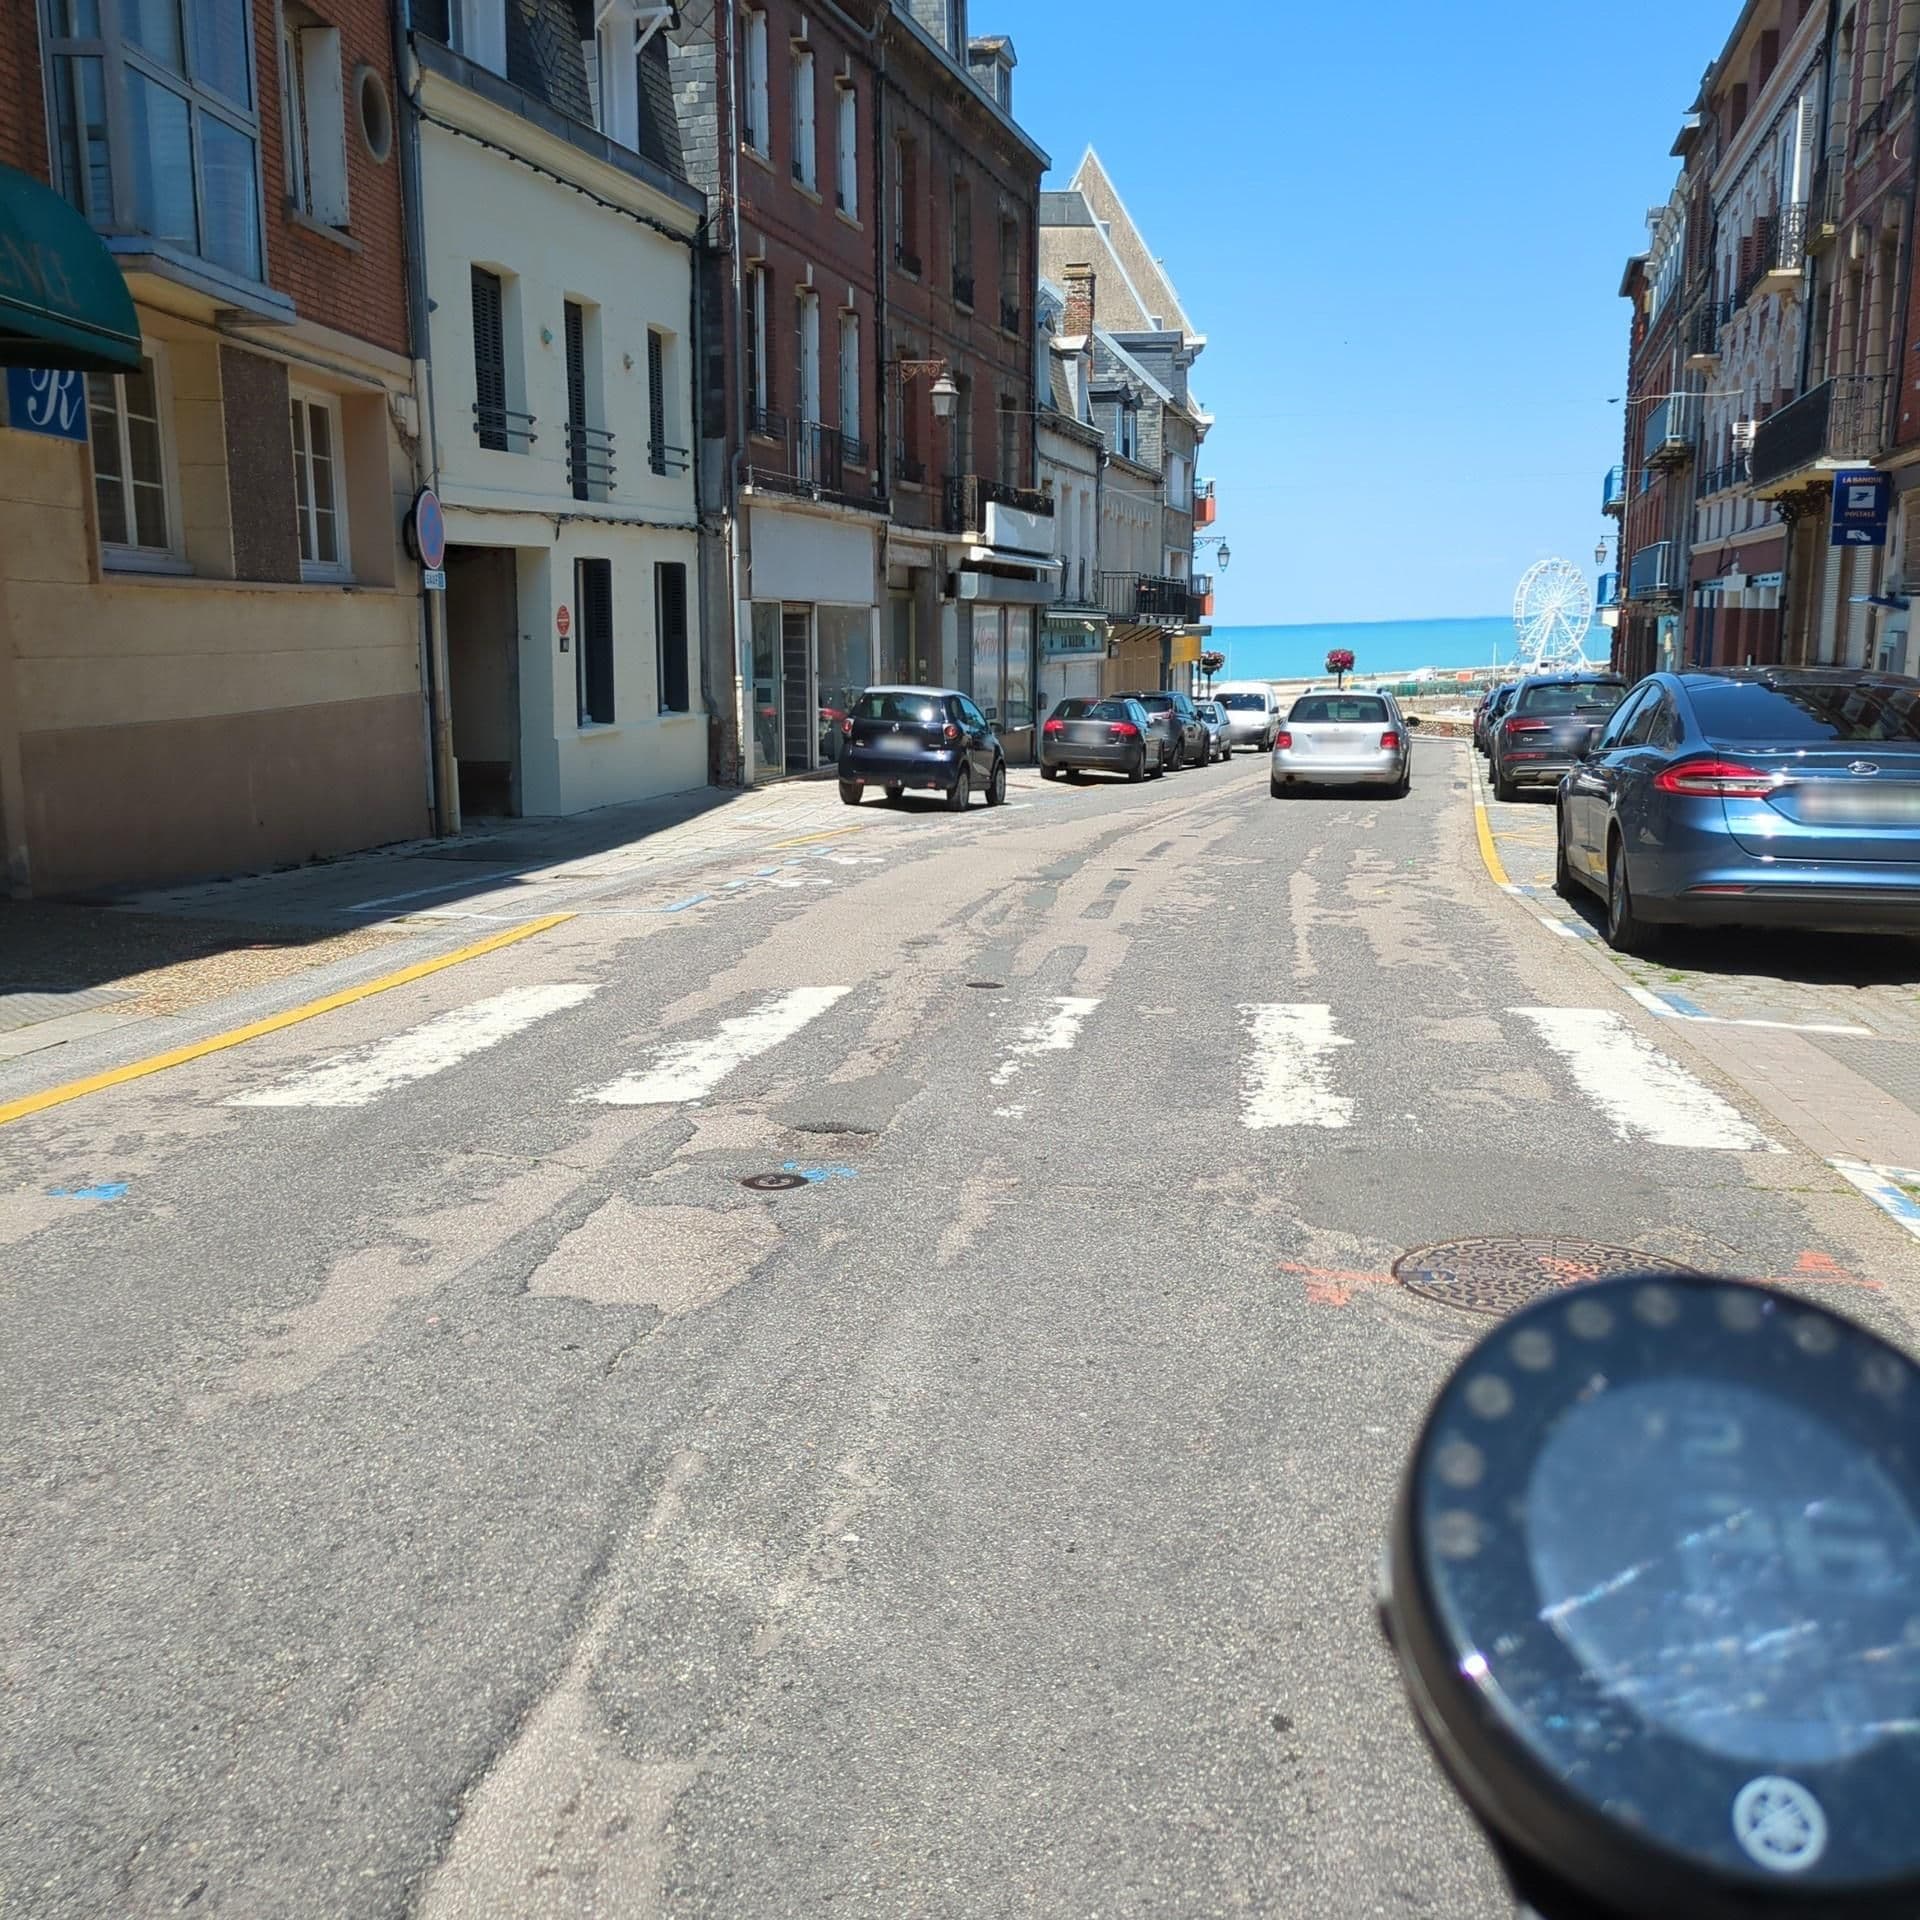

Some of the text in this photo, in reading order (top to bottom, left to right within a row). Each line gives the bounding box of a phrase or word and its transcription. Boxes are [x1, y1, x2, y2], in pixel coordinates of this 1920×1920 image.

[1842, 476, 1884, 484] LA BANQUE
[1844, 510, 1876, 518] POSTALE
